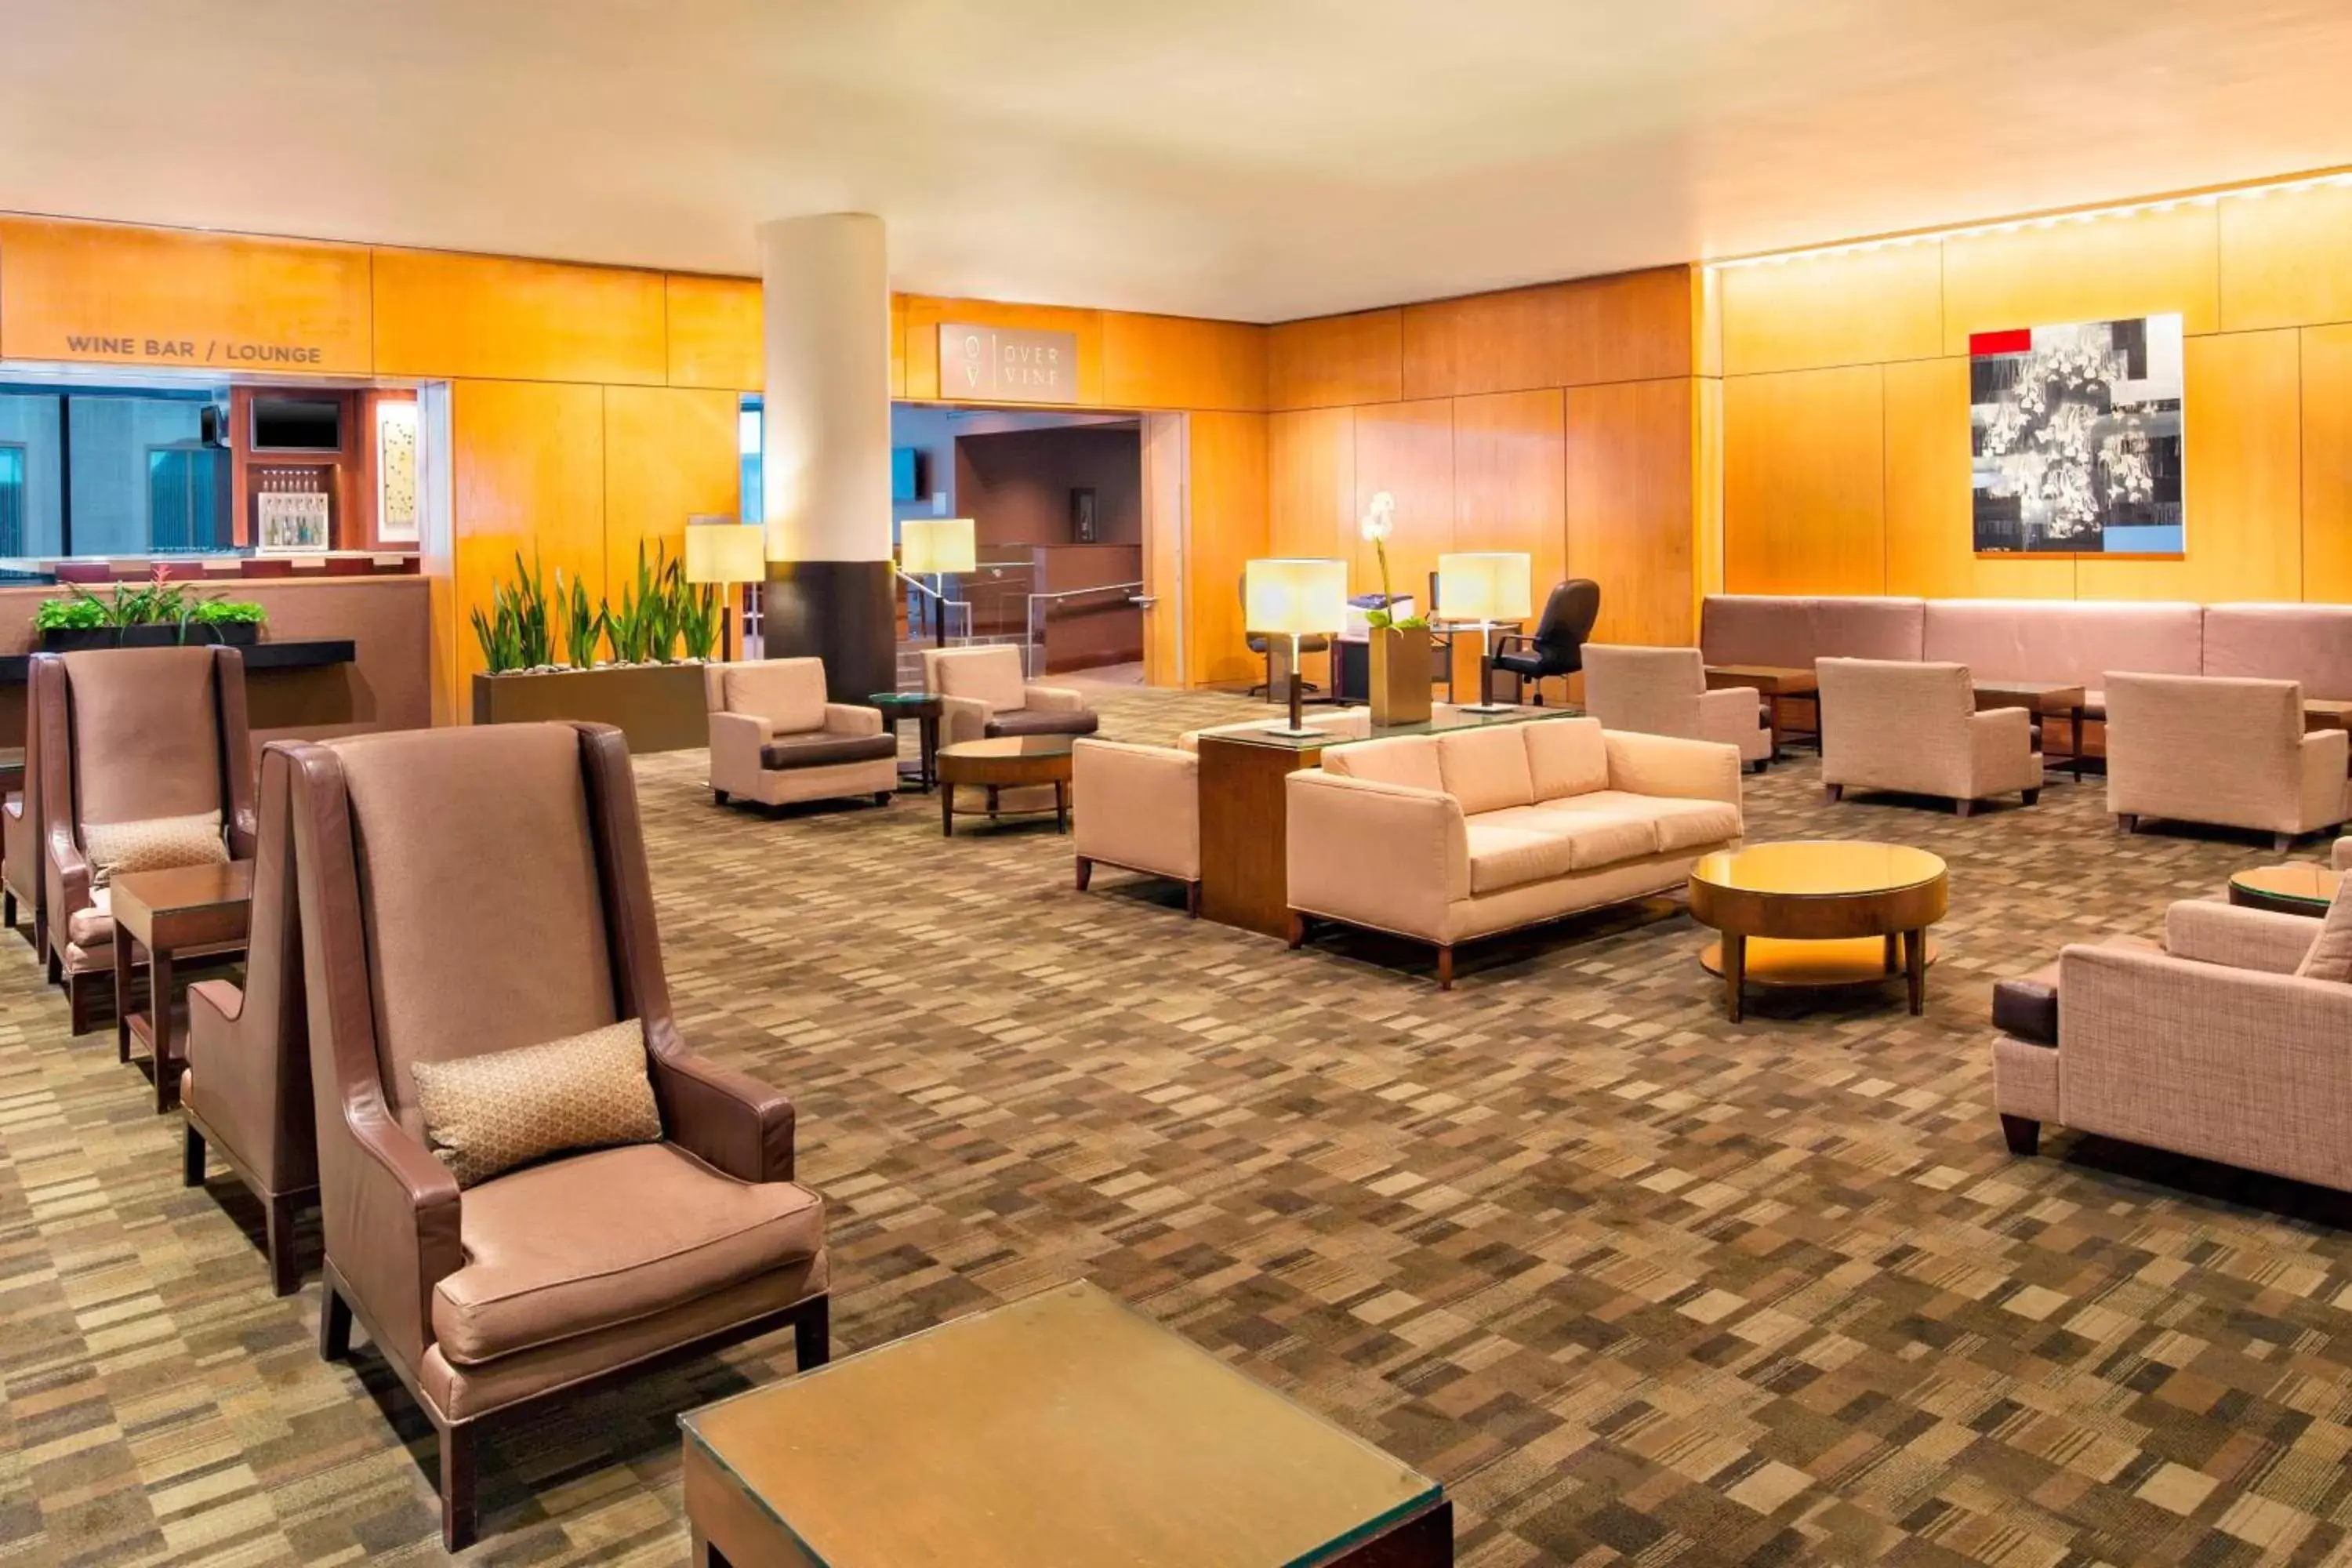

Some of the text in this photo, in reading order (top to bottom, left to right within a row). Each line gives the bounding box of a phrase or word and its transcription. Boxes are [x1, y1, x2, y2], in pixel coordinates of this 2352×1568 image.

[66, 335, 136, 355] WINE
[145, 339, 194, 358] BAR
[226, 343, 321, 364] LOUNGE
[1004, 345, 1058, 365] OVER
